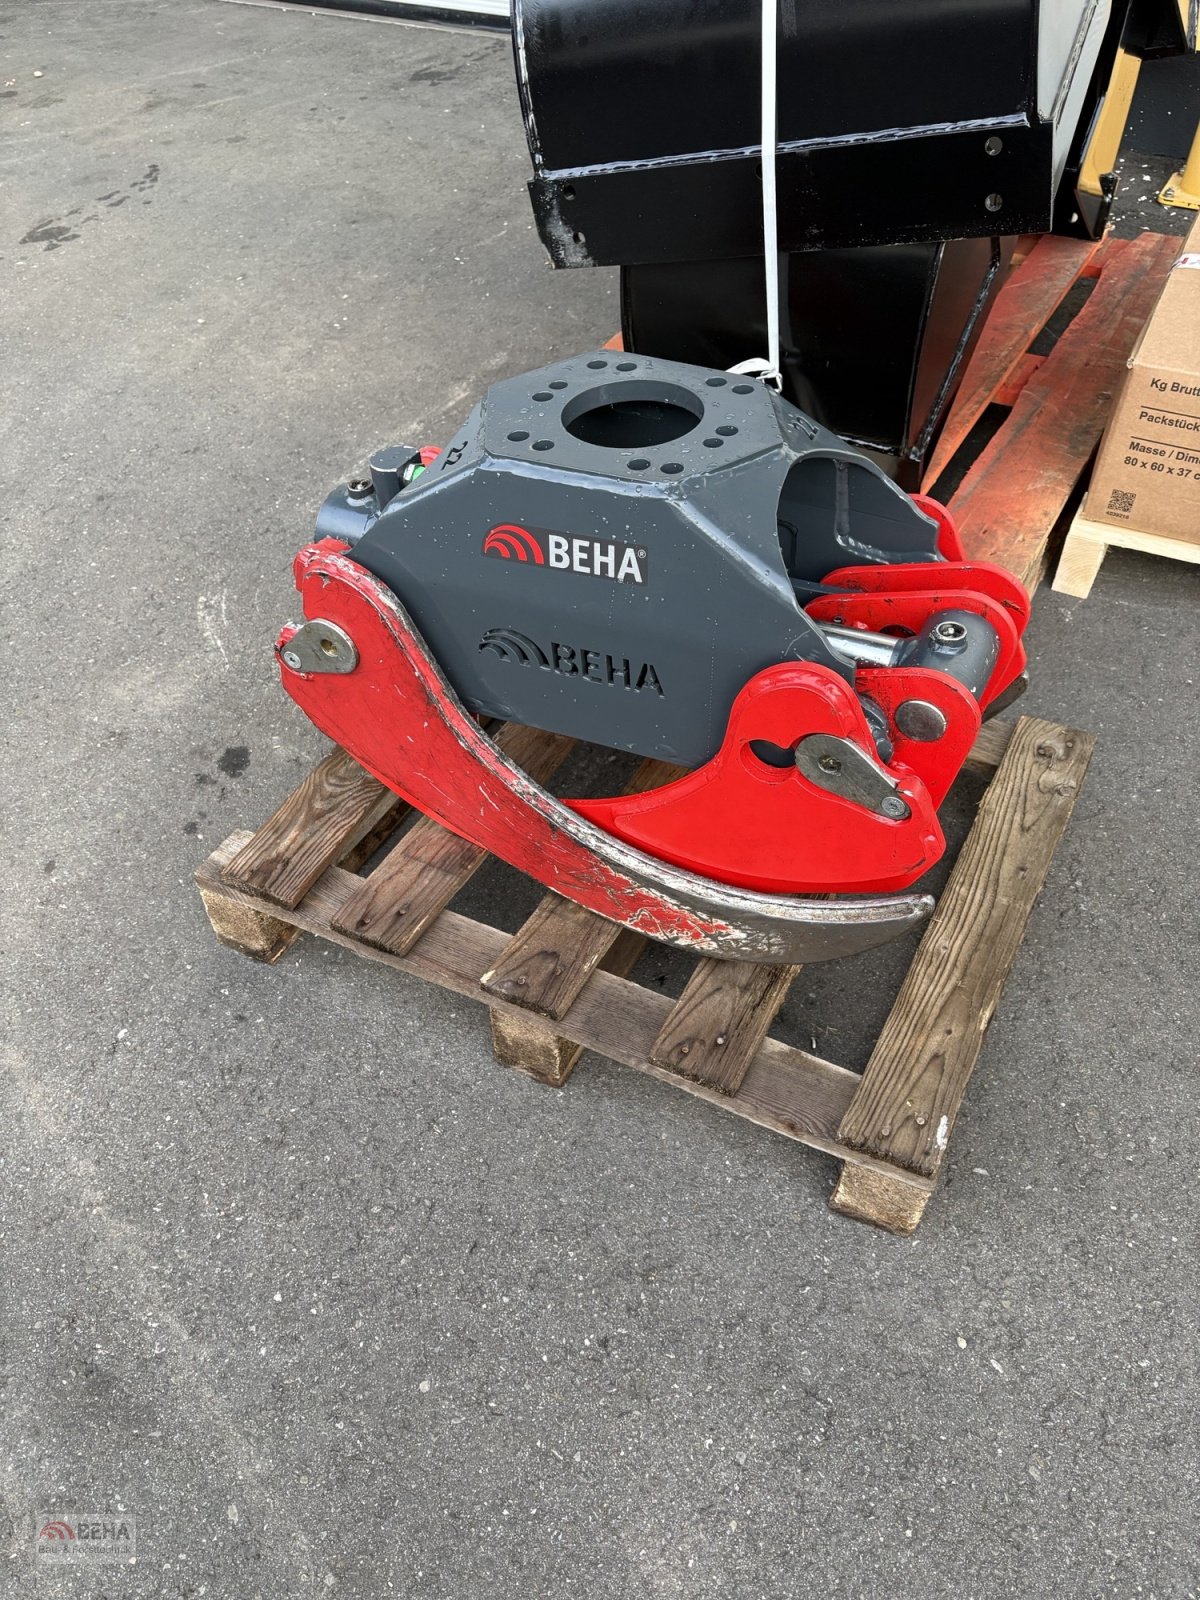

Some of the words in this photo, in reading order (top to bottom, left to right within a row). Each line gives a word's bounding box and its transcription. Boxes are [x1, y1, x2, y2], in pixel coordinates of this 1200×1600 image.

[1151, 378, 1168, 392] Kg
[1128, 441, 1166, 457] Masse
[1168, 450, 1174, 458] /
[1175, 451, 1200, 464] Dim
[1124, 455, 1139, 467] 80
[1140, 461, 1148, 469] x
[1150, 462, 1164, 472] 60
[1166, 467, 1175, 475] x
[1177, 468, 1192, 477] 37
[550, 642, 665, 698] BEHA
